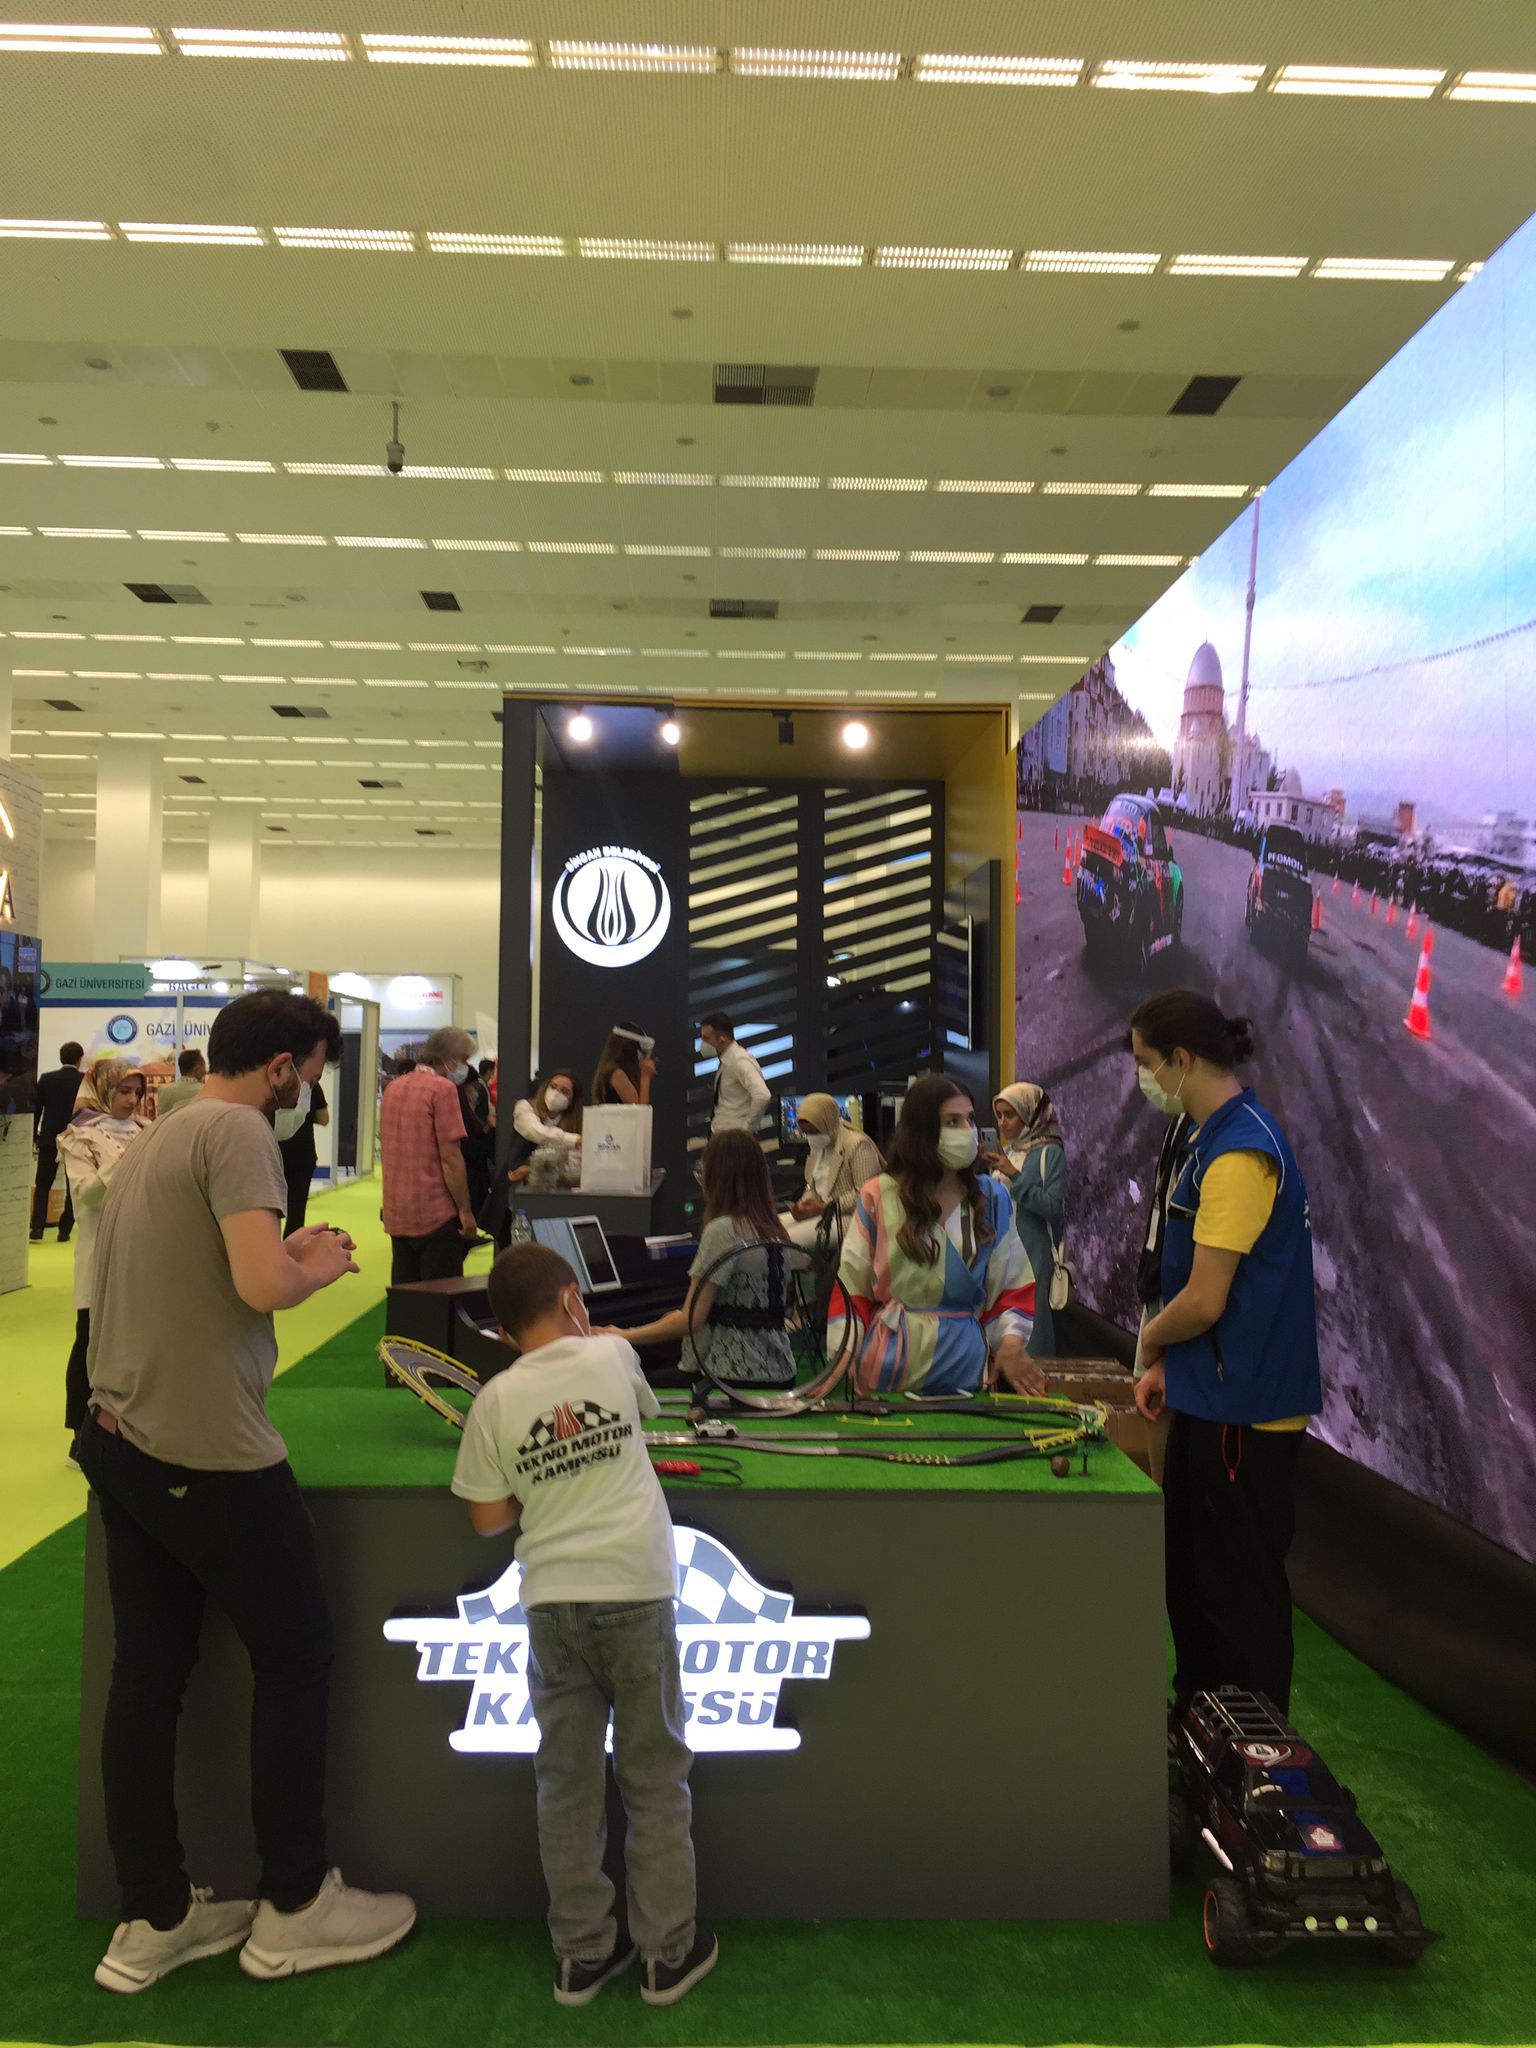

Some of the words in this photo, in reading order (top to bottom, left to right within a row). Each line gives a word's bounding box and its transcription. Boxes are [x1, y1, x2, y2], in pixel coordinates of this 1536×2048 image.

[55, 978, 77, 990] GAZİ
[80, 977, 145, 990] ÜNİVERSİTESİ
[146, 1019, 176, 1036] GAZİ
[515, 1442, 567, 1475] TEKNO
[571, 1423, 632, 1453] MOTOR
[422, 1641, 522, 1674] TEK
[678, 1640, 830, 1674] OTOR
